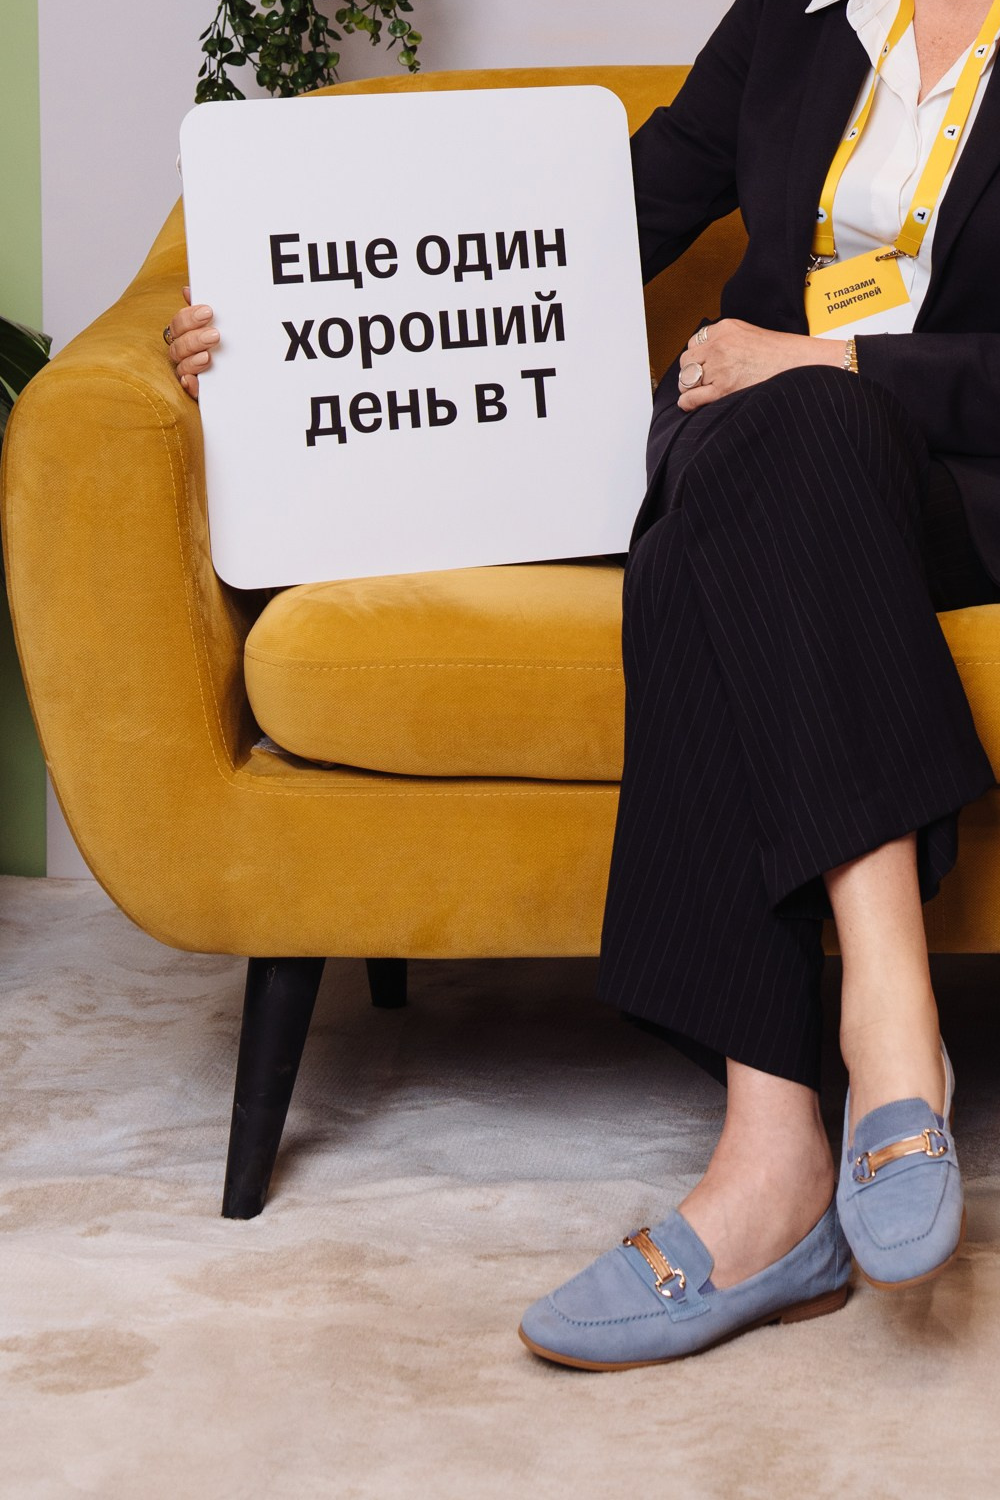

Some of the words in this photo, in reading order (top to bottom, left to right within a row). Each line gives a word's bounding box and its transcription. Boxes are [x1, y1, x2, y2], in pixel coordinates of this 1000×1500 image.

[269, 233, 399, 290] Еще
[416, 228, 568, 283] один
[824, 292, 832, 301] Т
[833, 277, 877, 299] глазами
[281, 289, 566, 370] хороший
[827, 286, 882, 314] родителей
[305, 387, 458, 447] день
[474, 382, 508, 424] в
[520, 367, 557, 419] Т
